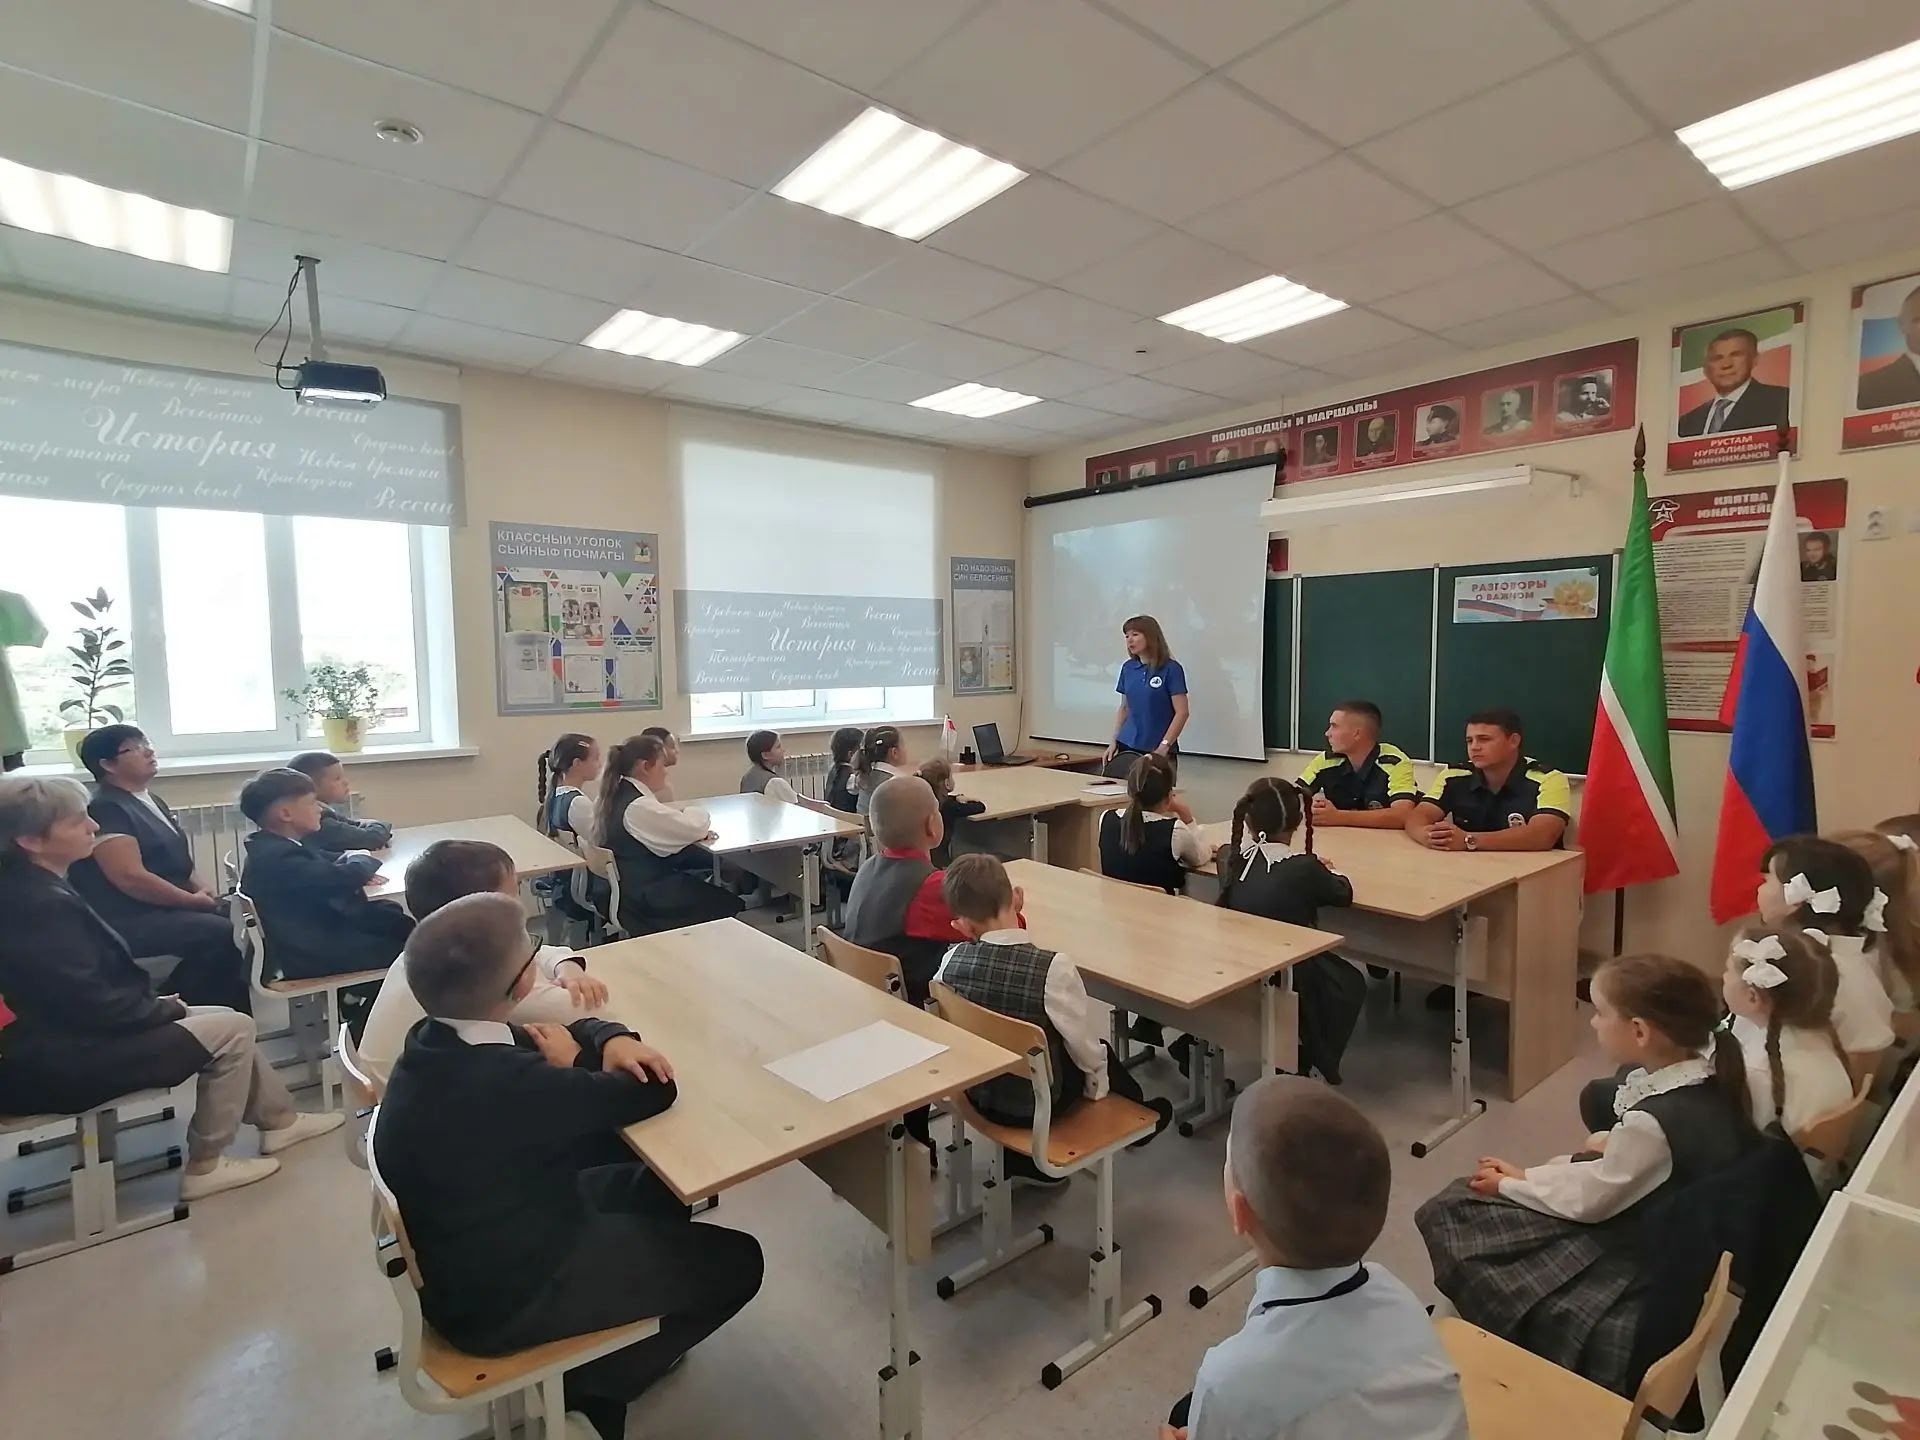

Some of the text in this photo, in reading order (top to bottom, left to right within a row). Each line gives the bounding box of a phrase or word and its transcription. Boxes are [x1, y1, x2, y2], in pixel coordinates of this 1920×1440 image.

[1212, 400, 1378, 443] ПОЛКОВОДЦЫ И МАРШАЛЫ
[82, 405, 277, 466] История
[1710, 435, 1753, 447] РУСТАМ
[1694, 442, 1769, 457] НУРГАЛИЕВИЧ
[1692, 450, 1770, 466] МИННИХАНОВ
[374, 486, 455, 515] России
[1713, 492, 1769, 506] КЛЯТВА
[1697, 502, 1772, 519] ЮНАРМЕЙЦ
[574, 535, 622, 549] УГОЛОК
[498, 543, 625, 561] СЫЙНЫФ ПОЧМАГЫ
[1472, 579, 1547, 592] РАЗГОВОРЫ
[1486, 591, 1535, 601] ВАЖНОМ
[863, 606, 901, 622] России
[769, 624, 857, 661] История
[900, 660, 941, 680] России
